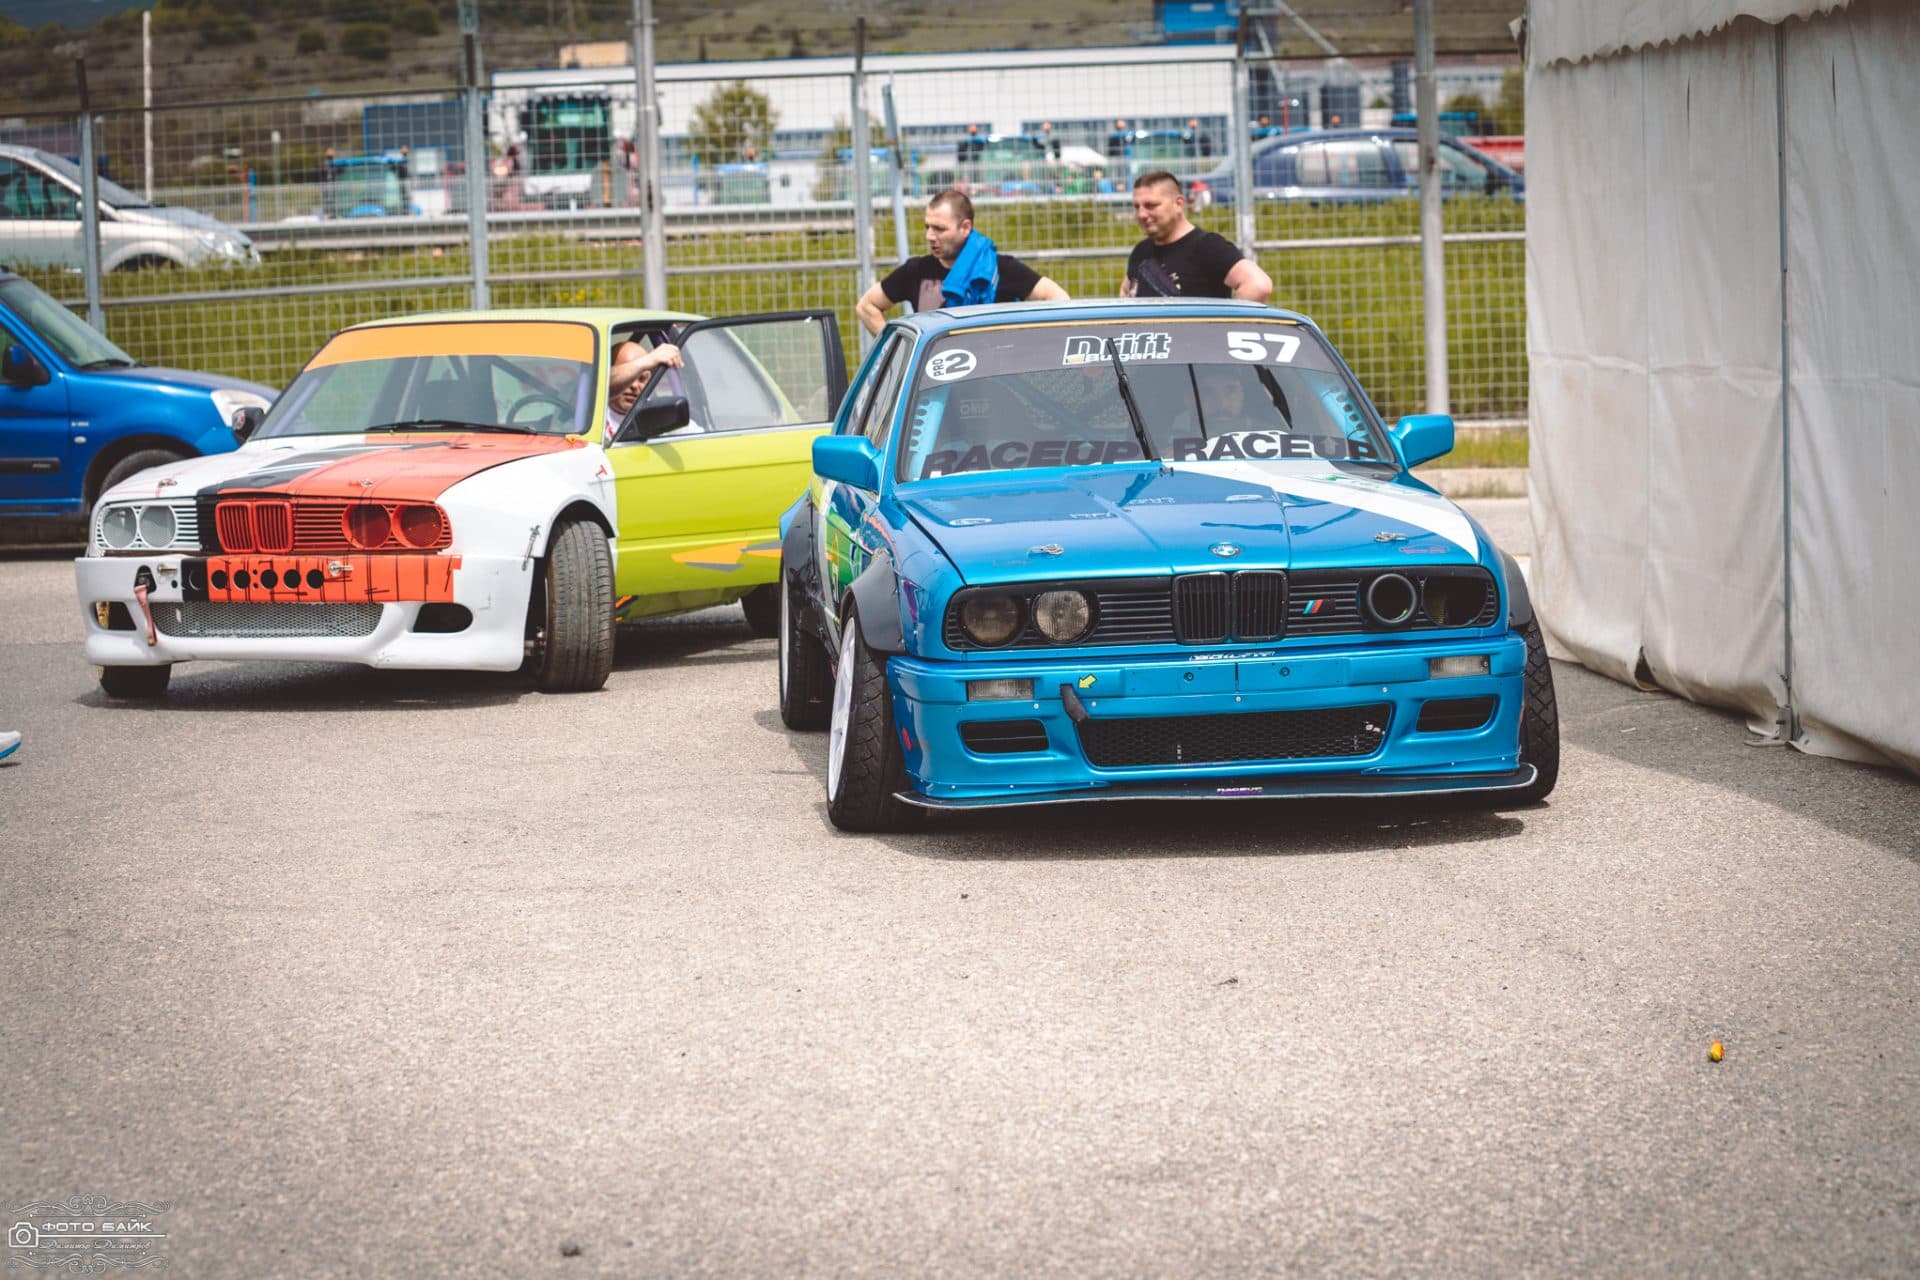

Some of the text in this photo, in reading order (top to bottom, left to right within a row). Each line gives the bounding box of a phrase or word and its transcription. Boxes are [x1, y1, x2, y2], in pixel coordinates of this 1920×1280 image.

[1063, 332, 1172, 361] Drift
[1085, 352, 1170, 362] Bugaria
[1227, 331, 1301, 363] 57
[932, 358, 945, 377] PRO
[945, 353, 970, 375] 2
[919, 433, 1378, 481] RACEUP RACEUP
